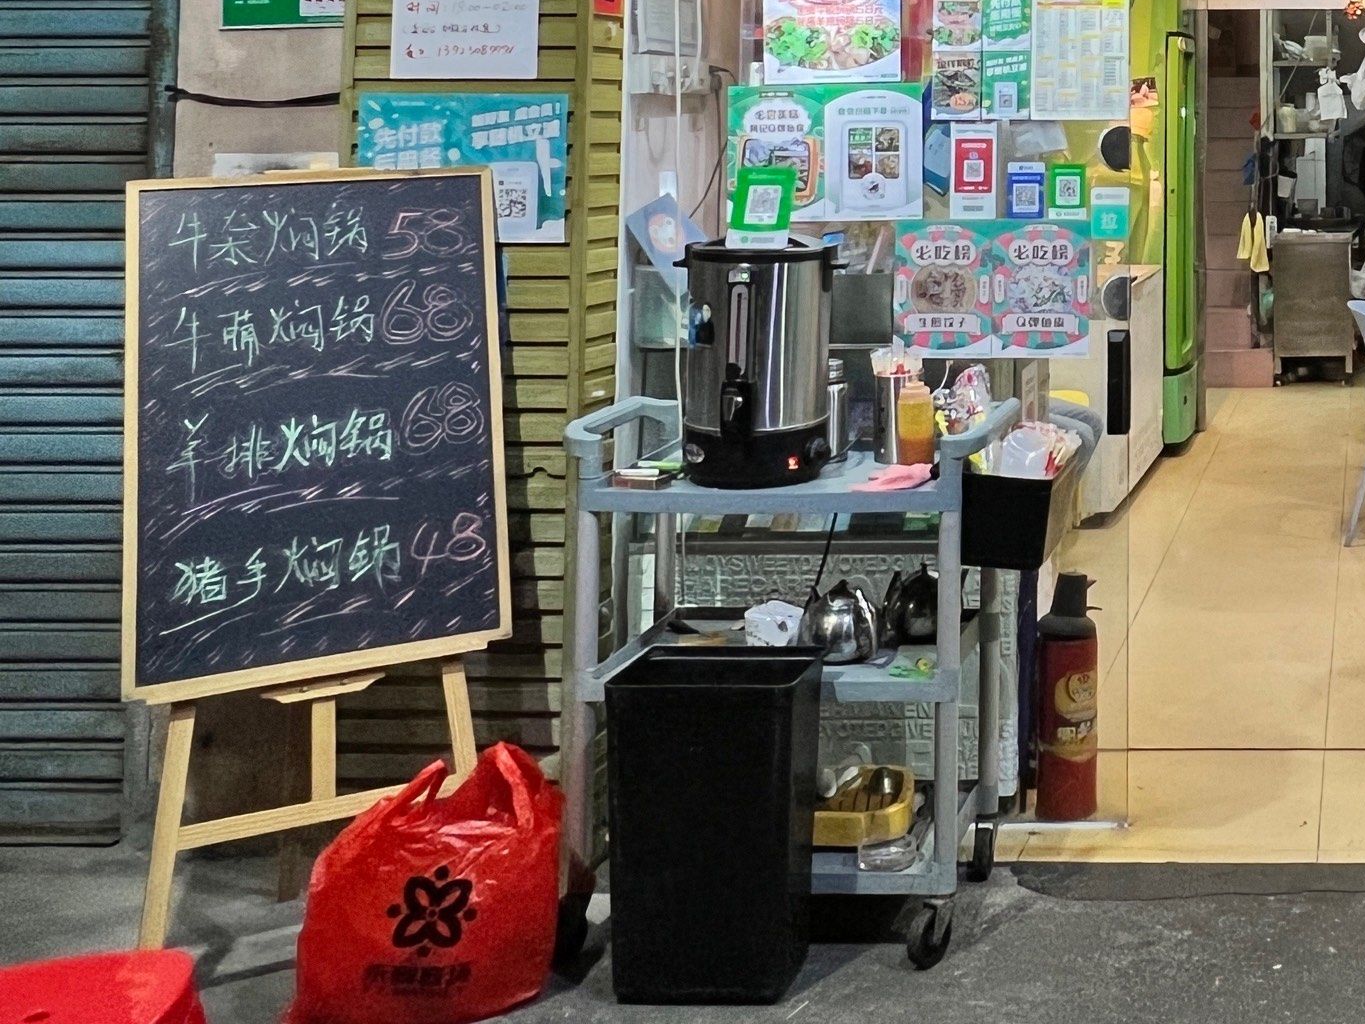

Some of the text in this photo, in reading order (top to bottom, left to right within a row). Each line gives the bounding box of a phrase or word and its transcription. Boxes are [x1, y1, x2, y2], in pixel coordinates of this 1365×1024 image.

[380, 278, 474, 346] 68
[401, 381, 485, 455] 68
[410, 511, 487, 563] 48
